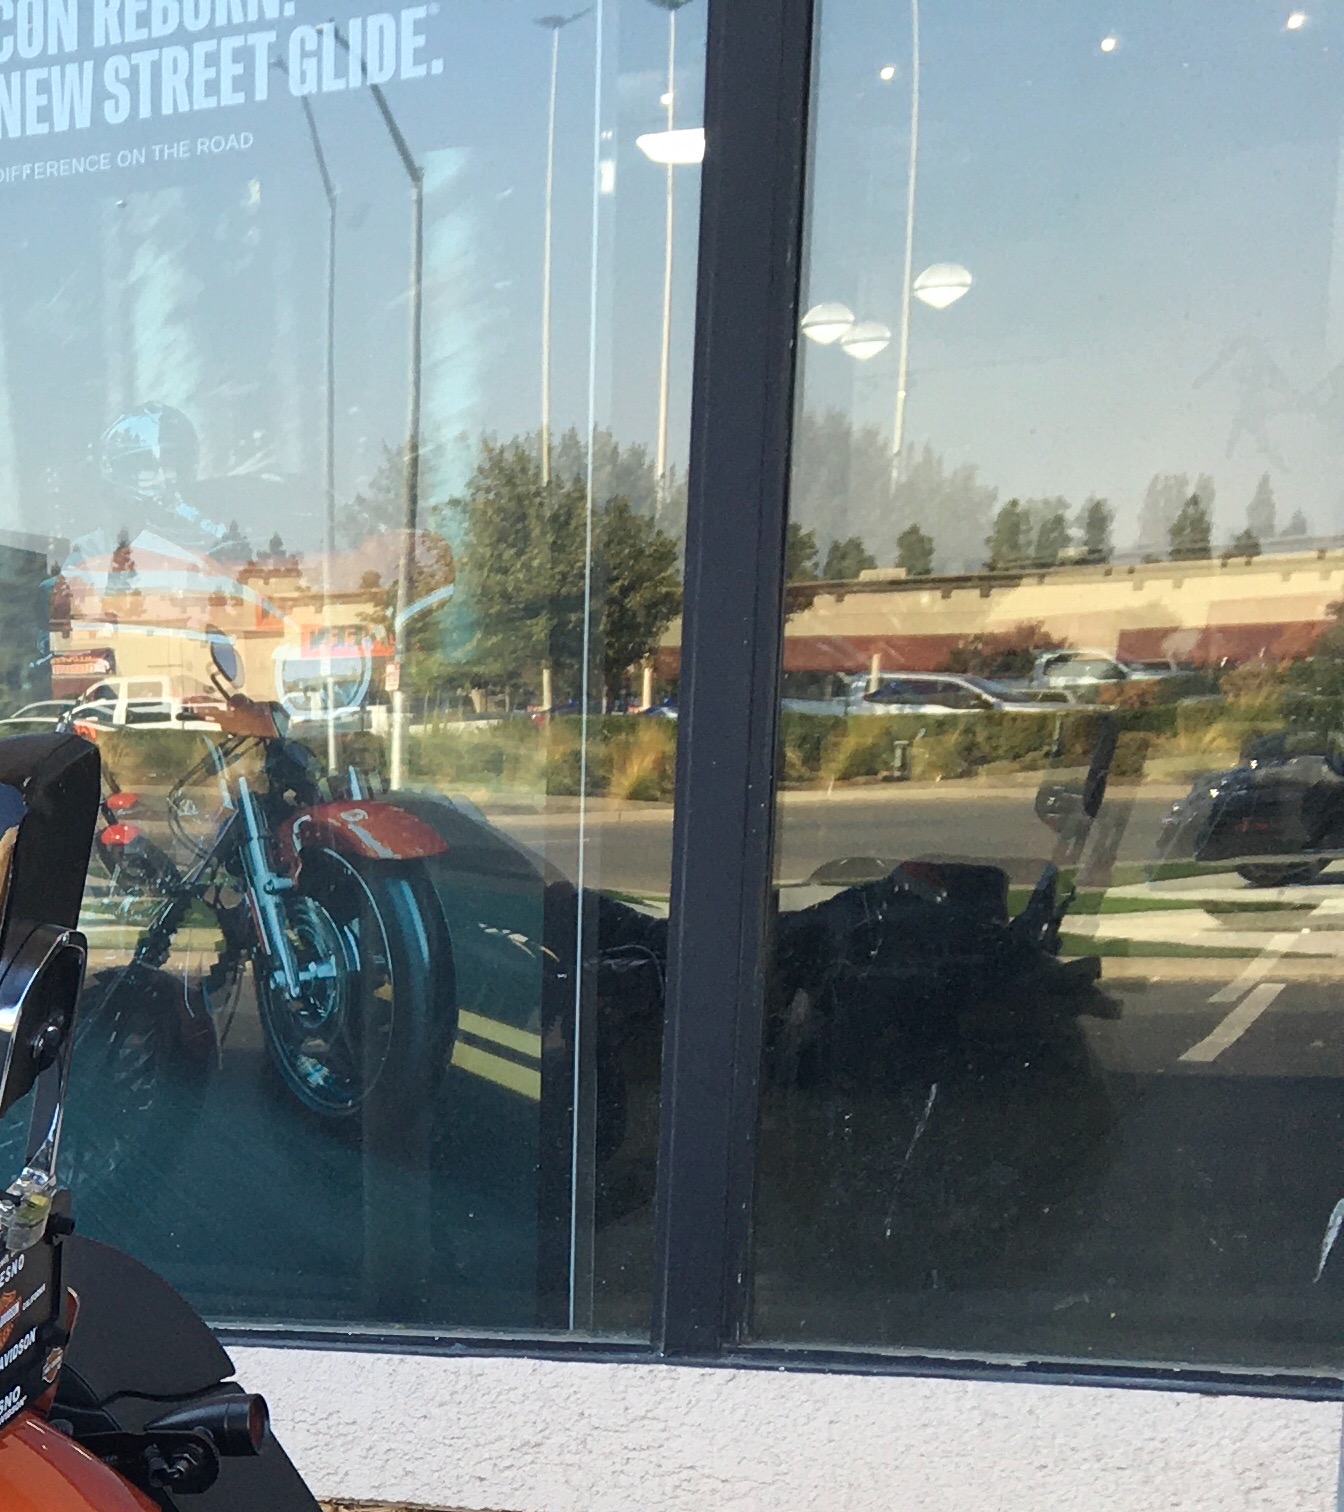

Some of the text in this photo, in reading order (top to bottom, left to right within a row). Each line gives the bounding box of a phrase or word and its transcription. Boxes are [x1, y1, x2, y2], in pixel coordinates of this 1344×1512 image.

[103, 31, 276, 126] STREET
[117, 148, 145, 167] ON
[154, 140, 190, 161] THE
[197, 132, 254, 155] ROAD
